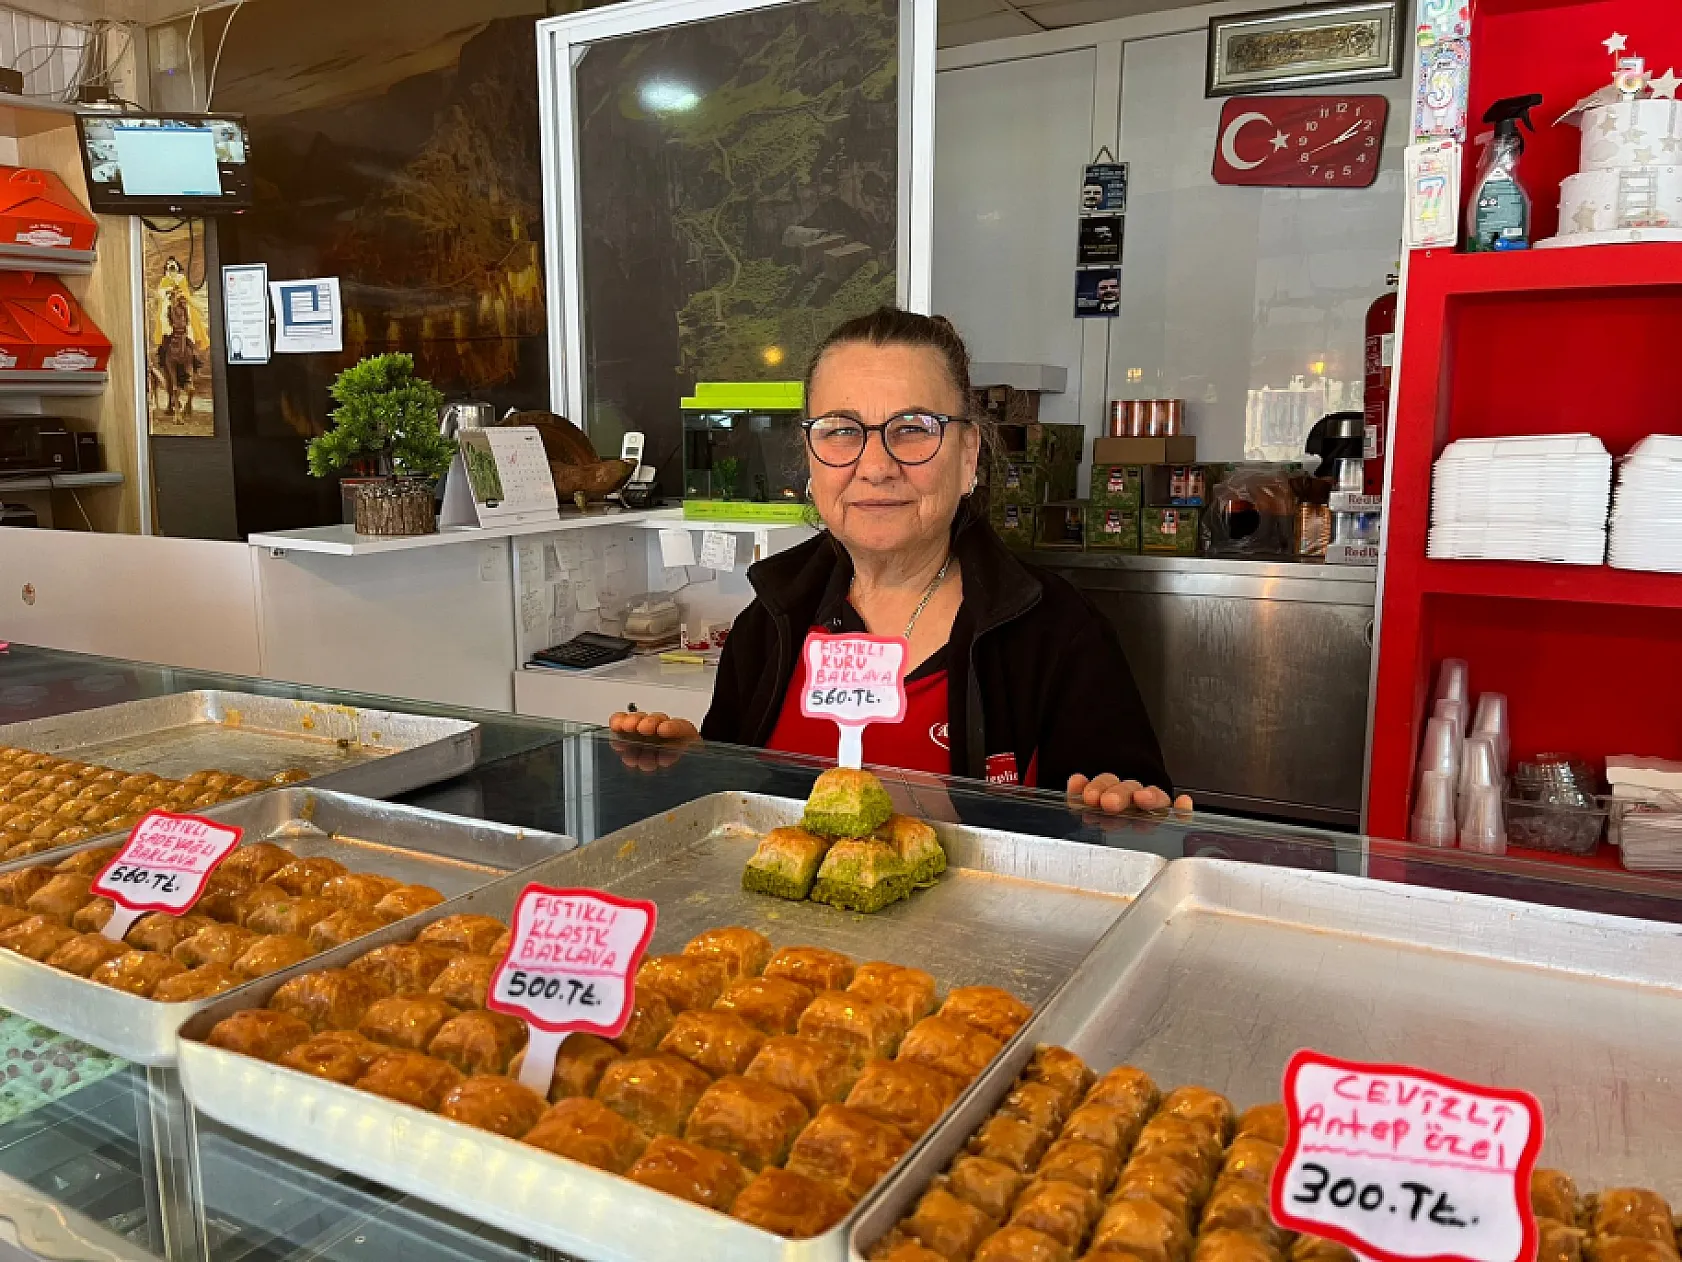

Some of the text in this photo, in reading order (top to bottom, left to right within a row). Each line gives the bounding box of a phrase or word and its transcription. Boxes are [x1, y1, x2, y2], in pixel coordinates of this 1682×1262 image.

[1319, 107, 1330, 119] 11
[1336, 102, 1348, 113] 12
[1305, 121, 1318, 132] 10
[1363, 120, 1372, 131] 2
[1299, 137, 1308, 146] 9
[1364, 137, 1375, 147] 3
[1300, 152, 1310, 163] 8
[1355, 153, 1366, 163] 4
[1310, 165, 1319, 176] 7
[1325, 169, 1335, 180] 6
[1342, 165, 1352, 176] 5
[820, 640, 884, 656] FISTIKLI
[821, 655, 868, 670] KURU
[815, 669, 893, 685] BAKLAVA
[150, 818, 209, 837] FISTIKLI
[128, 840, 198, 867] BAKLAVA
[533, 898, 617, 925] FISTIKLI
[520, 939, 617, 969] BAKLAVA
[1301, 1102, 1411, 1151] Antep
